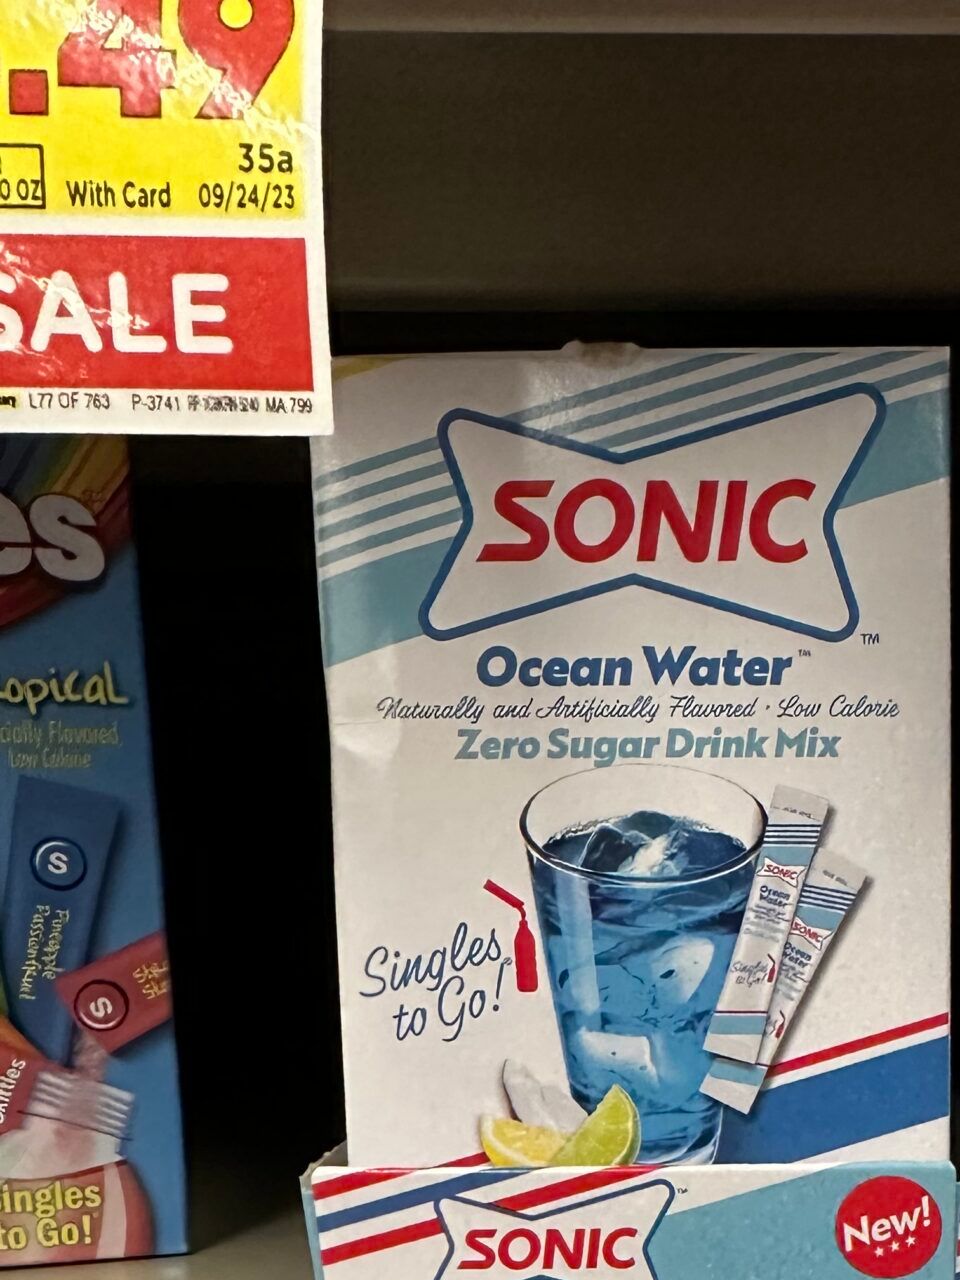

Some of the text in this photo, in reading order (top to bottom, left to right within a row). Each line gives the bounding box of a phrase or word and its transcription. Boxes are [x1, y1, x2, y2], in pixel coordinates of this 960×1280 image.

[238, 143, 293, 173] 35a
[66, 181, 295, 213] With Card 09/24/23
[476, 479, 817, 563] SONIC
[476, 645, 792, 687] Ocean Water
[376, 696, 900, 723] Naturally and Artificially Flavored Low Calorie
[455, 728, 841, 768] Zero Sugar Drink Mix
[360, 922, 503, 997] Singles
[393, 957, 512, 1042] to Go!
[843, 1195, 931, 1247] New!
[457, 1228, 638, 1270] SONIC
